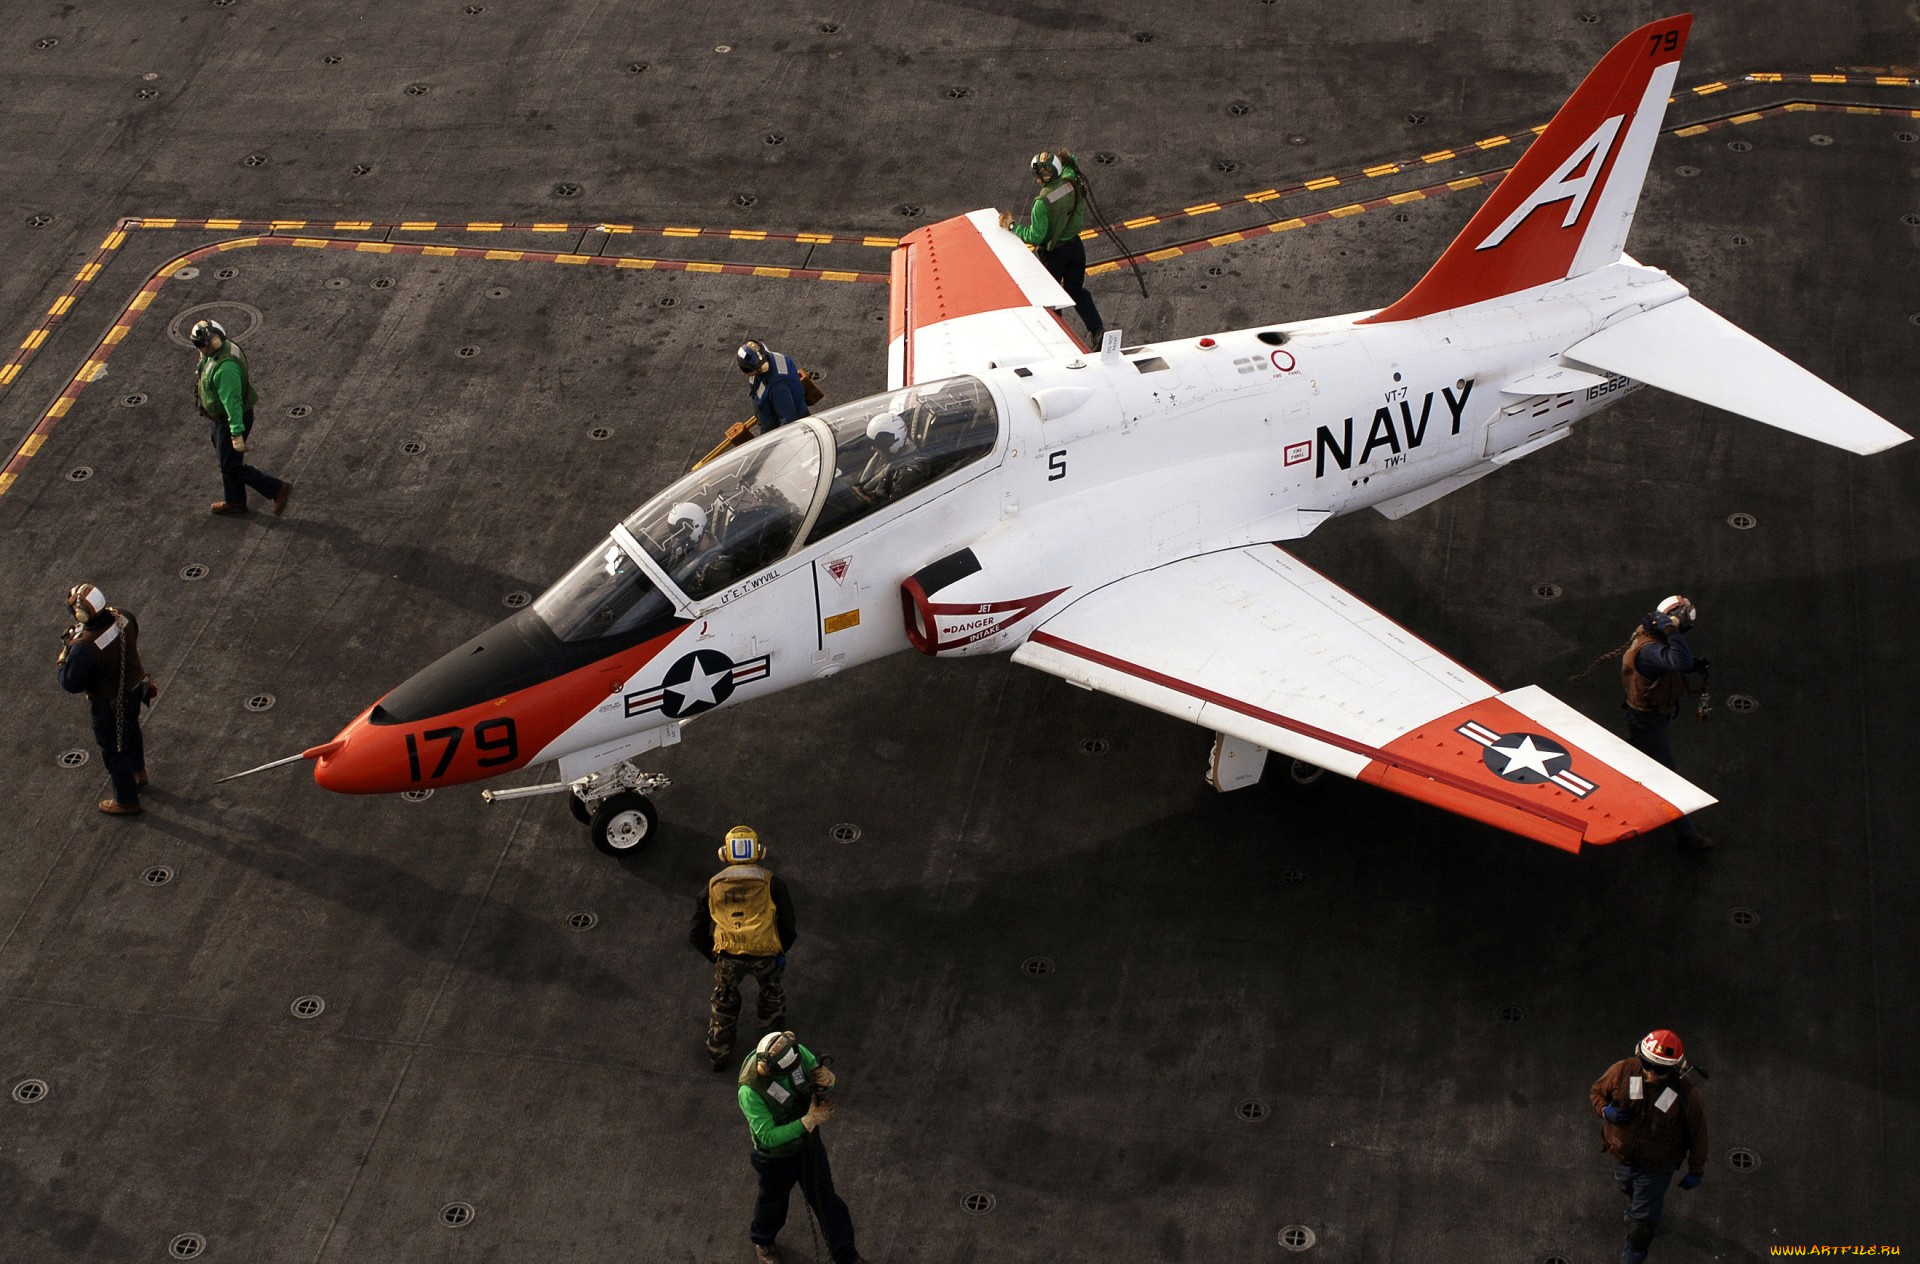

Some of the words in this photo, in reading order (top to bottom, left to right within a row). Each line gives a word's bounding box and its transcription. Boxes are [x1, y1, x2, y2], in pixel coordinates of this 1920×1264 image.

[1651, 30, 1678, 56] 79
[1475, 114, 1625, 251] A
[1385, 386, 1408, 403] VT-7
[1586, 375, 1631, 401] 165621
[1315, 379, 1475, 479] NAVY
[721, 594, 729, 604] LT
[751, 570, 780, 588] WYVILL
[978, 604, 992, 613] JET
[951, 617, 994, 634] DANGER
[969, 625, 1000, 642] INTAKE
[405, 717, 518, 782] 179
